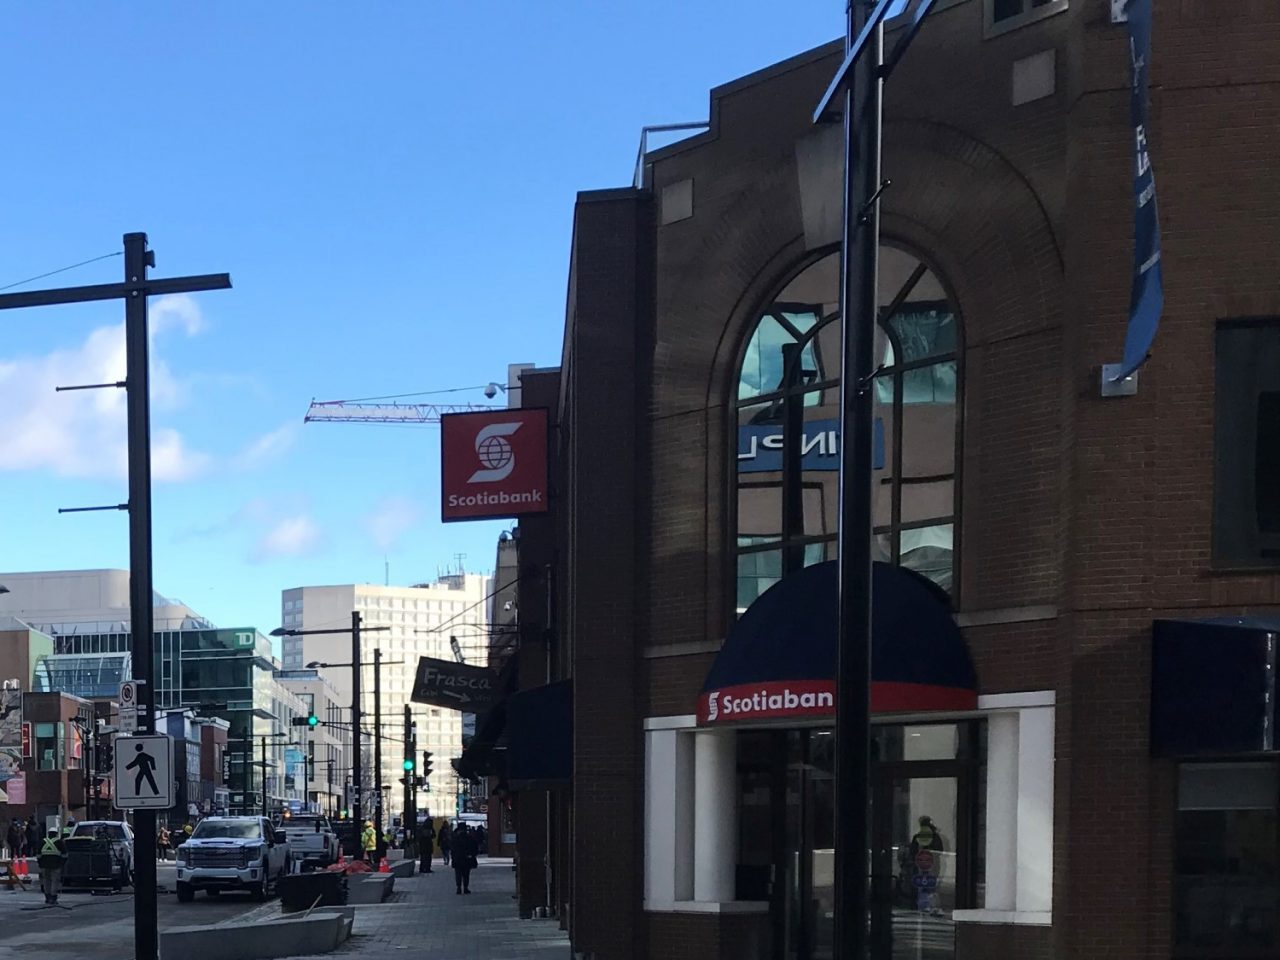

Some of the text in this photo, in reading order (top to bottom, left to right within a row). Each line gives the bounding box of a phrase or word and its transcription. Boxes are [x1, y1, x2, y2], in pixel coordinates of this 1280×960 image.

[448, 489, 542, 507] Scotiabank
[235, 632, 254, 646] TD
[423, 668, 492, 690] Frasca
[723, 689, 834, 714] Scotiaban
